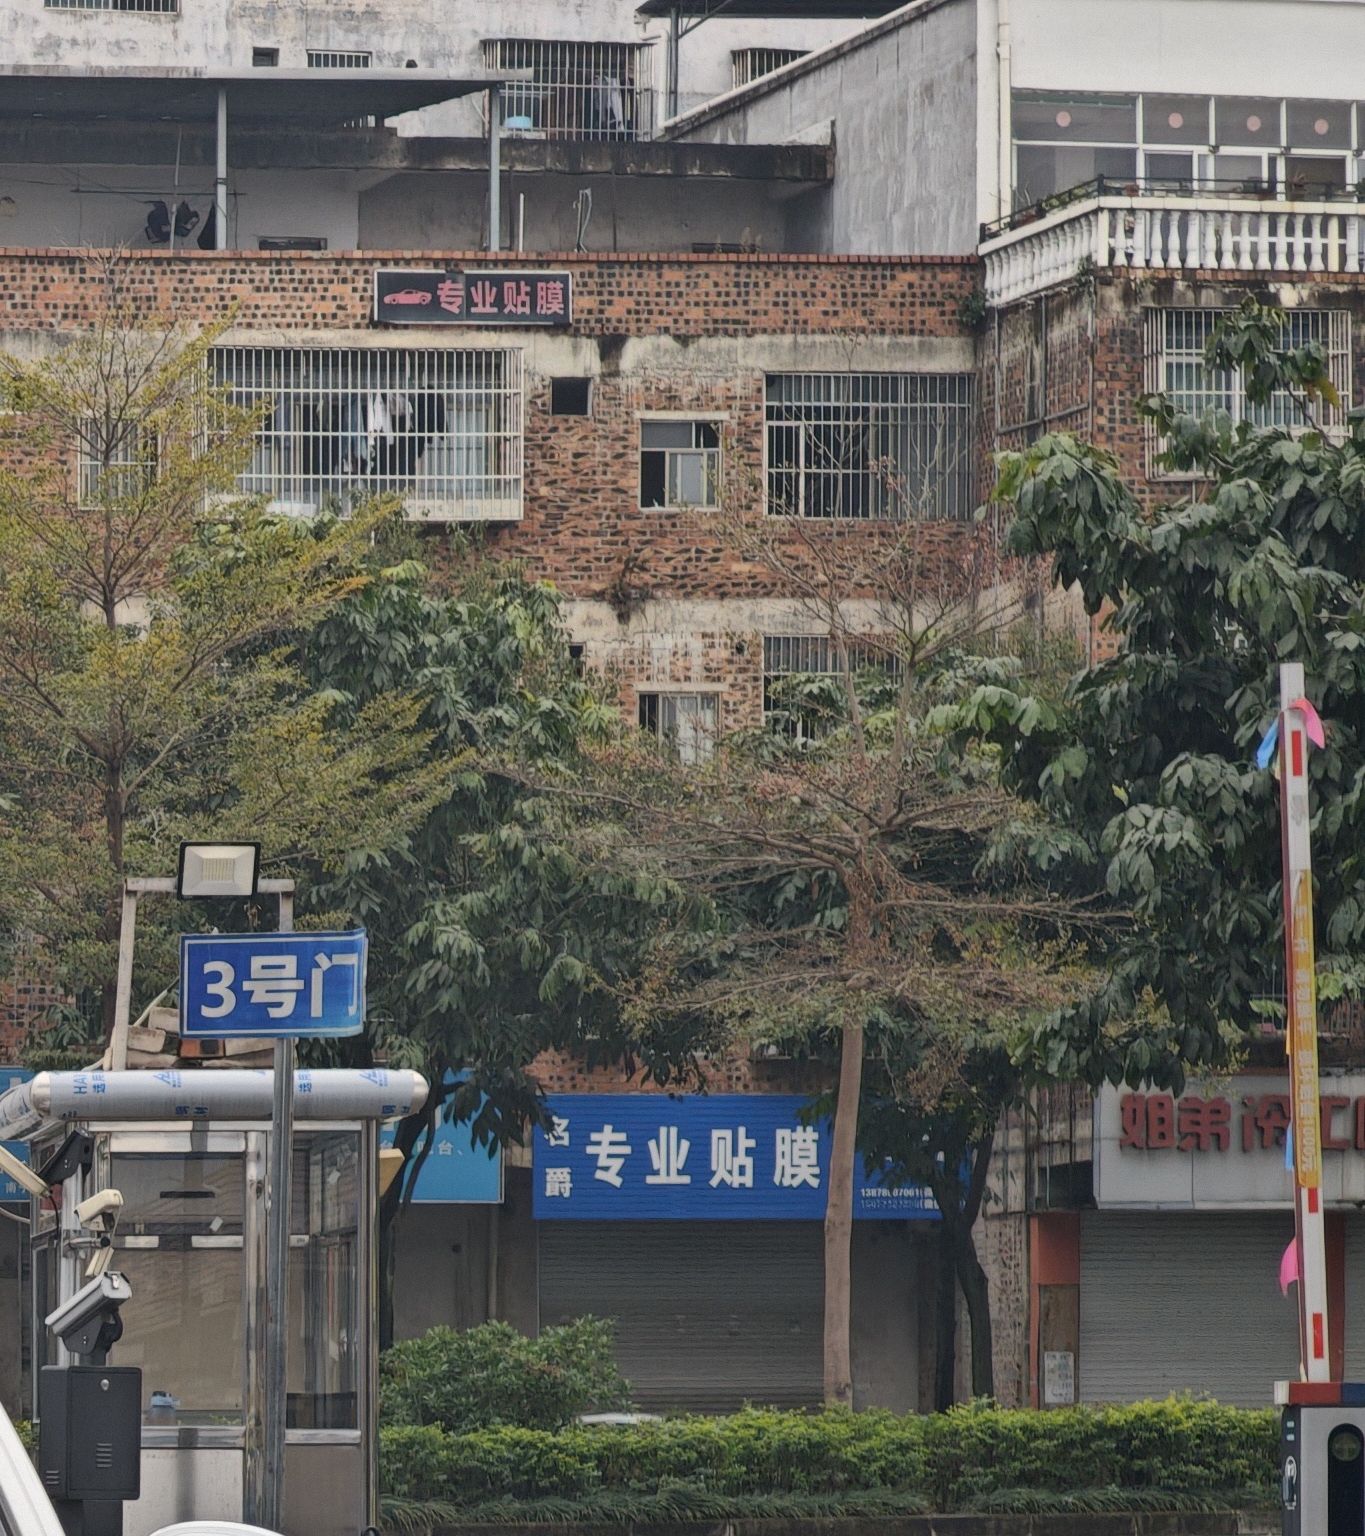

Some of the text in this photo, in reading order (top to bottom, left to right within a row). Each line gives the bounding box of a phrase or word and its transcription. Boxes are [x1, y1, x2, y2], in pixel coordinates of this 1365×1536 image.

[436, 279, 565, 315] 专业贴膜
[200, 952, 359, 1018] 3号门
[585, 1124, 821, 1189] 专业贴膜
